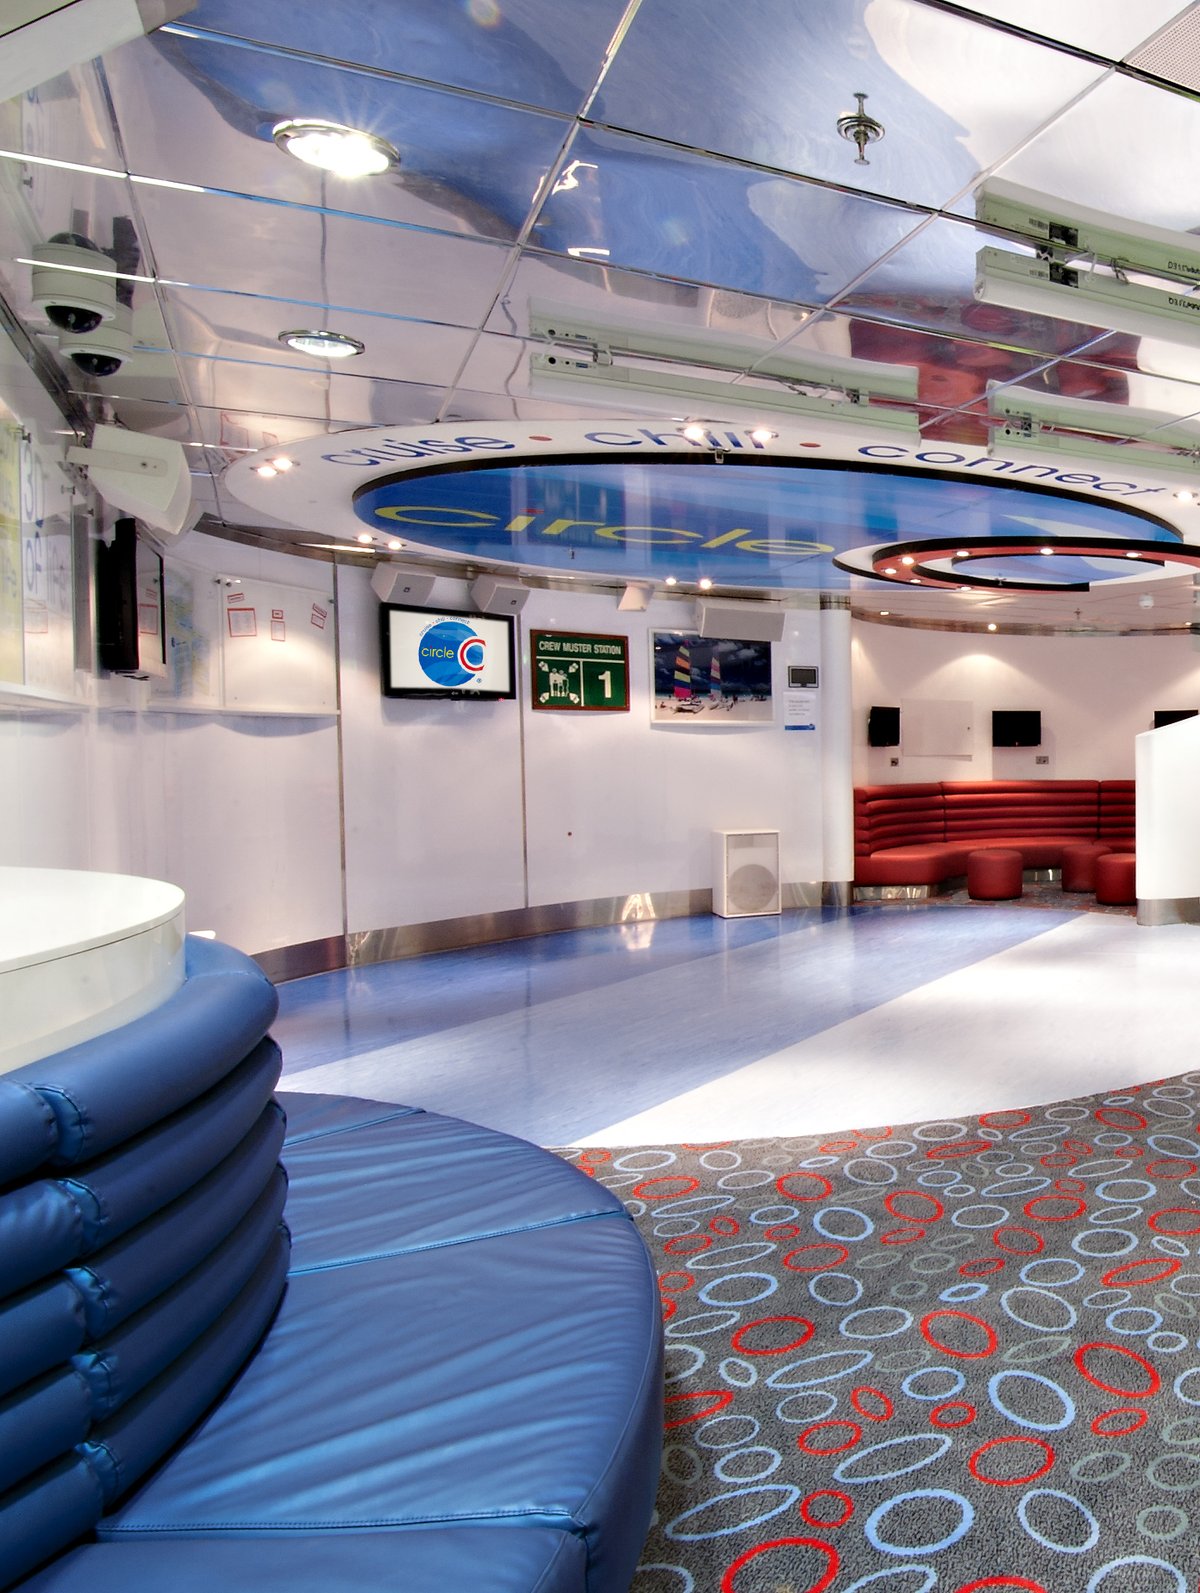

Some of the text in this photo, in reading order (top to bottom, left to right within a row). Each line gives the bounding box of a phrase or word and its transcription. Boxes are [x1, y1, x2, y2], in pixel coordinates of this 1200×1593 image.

[320, 435, 515, 467] cruise
[858, 445, 1166, 496] connect
[374, 505, 835, 555] circle
[421, 645, 455, 659] circle
[538, 641, 622, 655] CREW MUSTER STATION
[598, 670, 612, 699] 1
